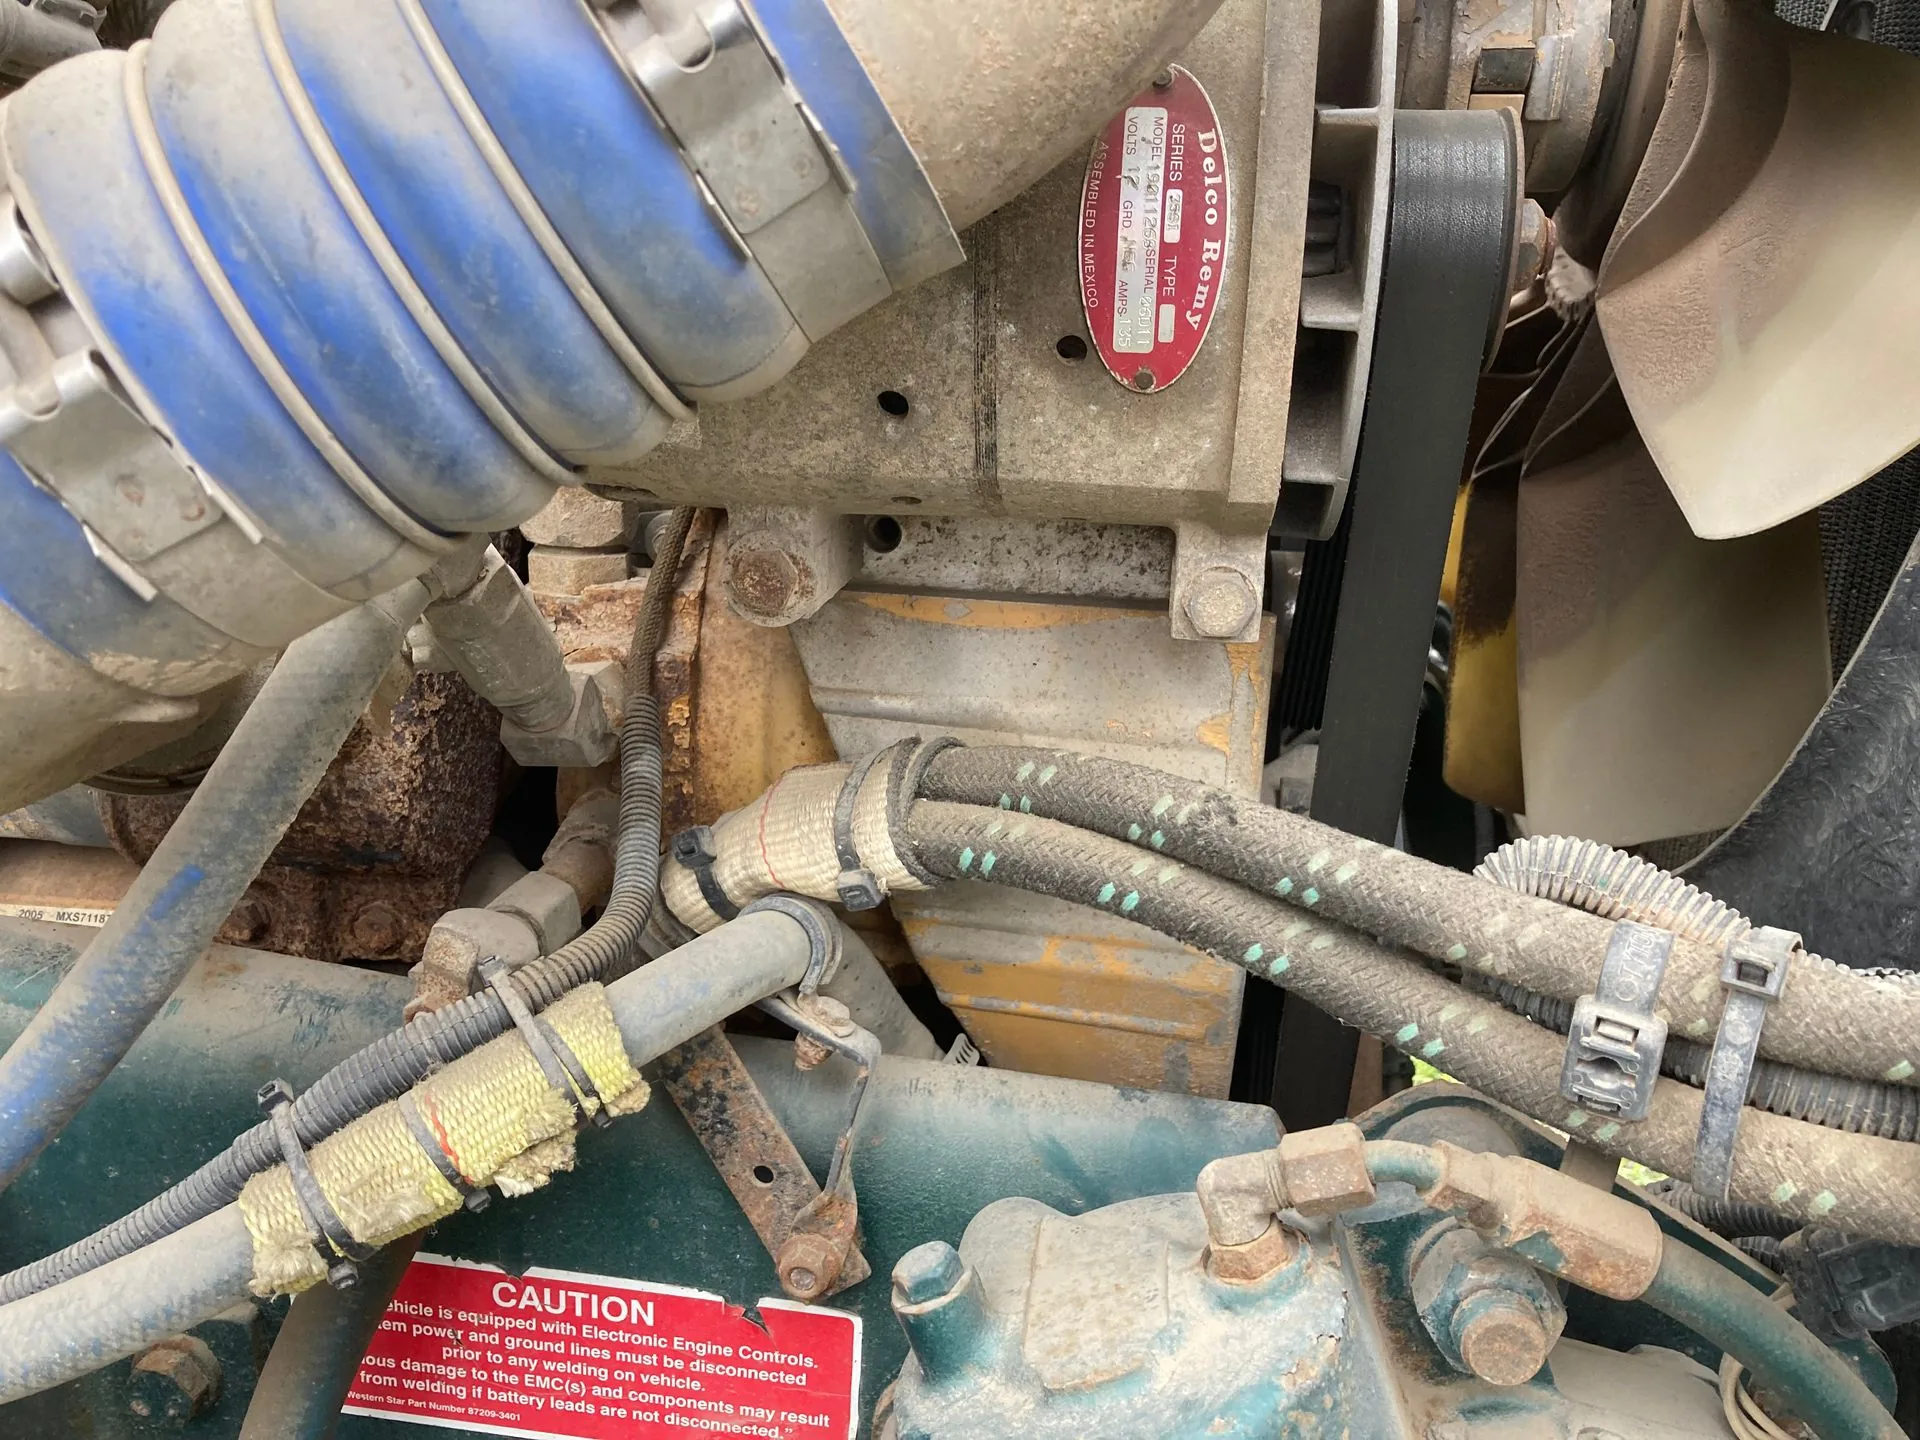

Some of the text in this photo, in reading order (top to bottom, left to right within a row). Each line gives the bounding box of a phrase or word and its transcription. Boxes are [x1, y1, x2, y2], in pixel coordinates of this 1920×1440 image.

[1126, 116, 1139, 156] VOLTS
[1151, 116, 1165, 161] MODEL
[1169, 123, 1186, 182] SERIES
[1084, 141, 1109, 308] ASSEMBLED IN MEXICO
[1185, 128, 1223, 331] Delco Remy
[1143, 248, 1156, 294] SERIAL
[1163, 256, 1177, 297] TYPE
[1118, 318, 1133, 347] 135
[18, 908, 44, 921] 2005
[492, 1281, 654, 1327] CAUTION
[412, 1324, 464, 1343] power
[468, 1331, 499, 1345] and
[504, 1336, 565, 1354] ground
[570, 1342, 611, 1360] lines
[615, 1351, 658, 1367] must
[663, 1354, 685, 1370] be
[688, 1358, 807, 1386] disconnected
[438, 1305, 453, 1320] is
[457, 1310, 537, 1331] equipped
[541, 1320, 577, 1336] with
[582, 1324, 668, 1349] Electronic
[673, 1336, 733, 1357] Engine
[738, 1345, 818, 1369] Controls.
[442, 1346, 705, 1392] prior to any welding on vehicle.
[347, 1390, 520, 1421] Western Star Part Number 87209-3401
[359, 1370, 397, 1387] from
[402, 1378, 467, 1400] welding
[471, 1385, 483, 1399] if
[487, 1387, 545, 1410] battery
[549, 1395, 596, 1414] leads
[599, 1405, 628, 1419] are
[632, 1409, 660, 1423] not
[400, 1358, 467, 1380] damage
[471, 1367, 488, 1381] to
[492, 1370, 519, 1385] the
[524, 1373, 586, 1397] EMC(s)
[591, 1385, 623, 1399] and
[627, 1390, 735, 1417] components
[739, 1405, 776, 1423] may
[779, 1410, 830, 1428] result
